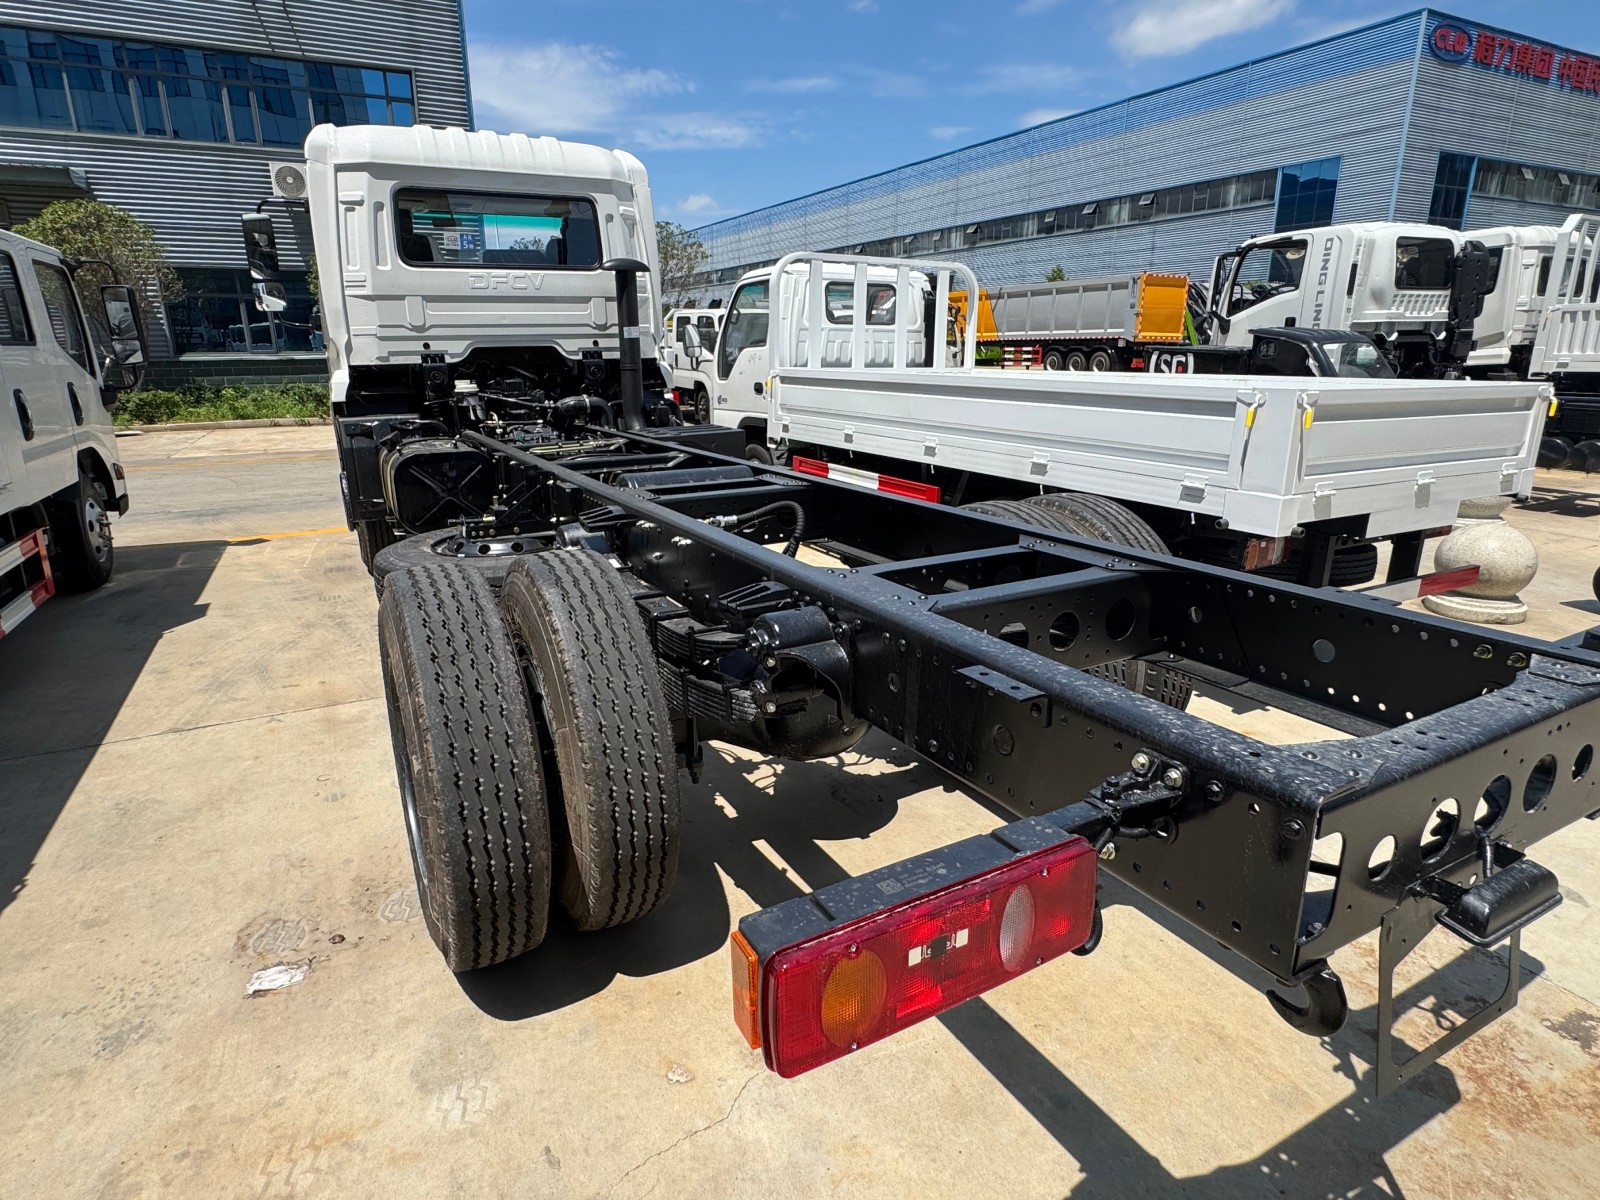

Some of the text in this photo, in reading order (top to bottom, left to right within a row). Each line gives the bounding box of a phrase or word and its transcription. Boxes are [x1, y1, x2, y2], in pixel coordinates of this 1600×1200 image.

[1473, 30, 1555, 79] 程力集团
[468, 272, 545, 290] DFCV
